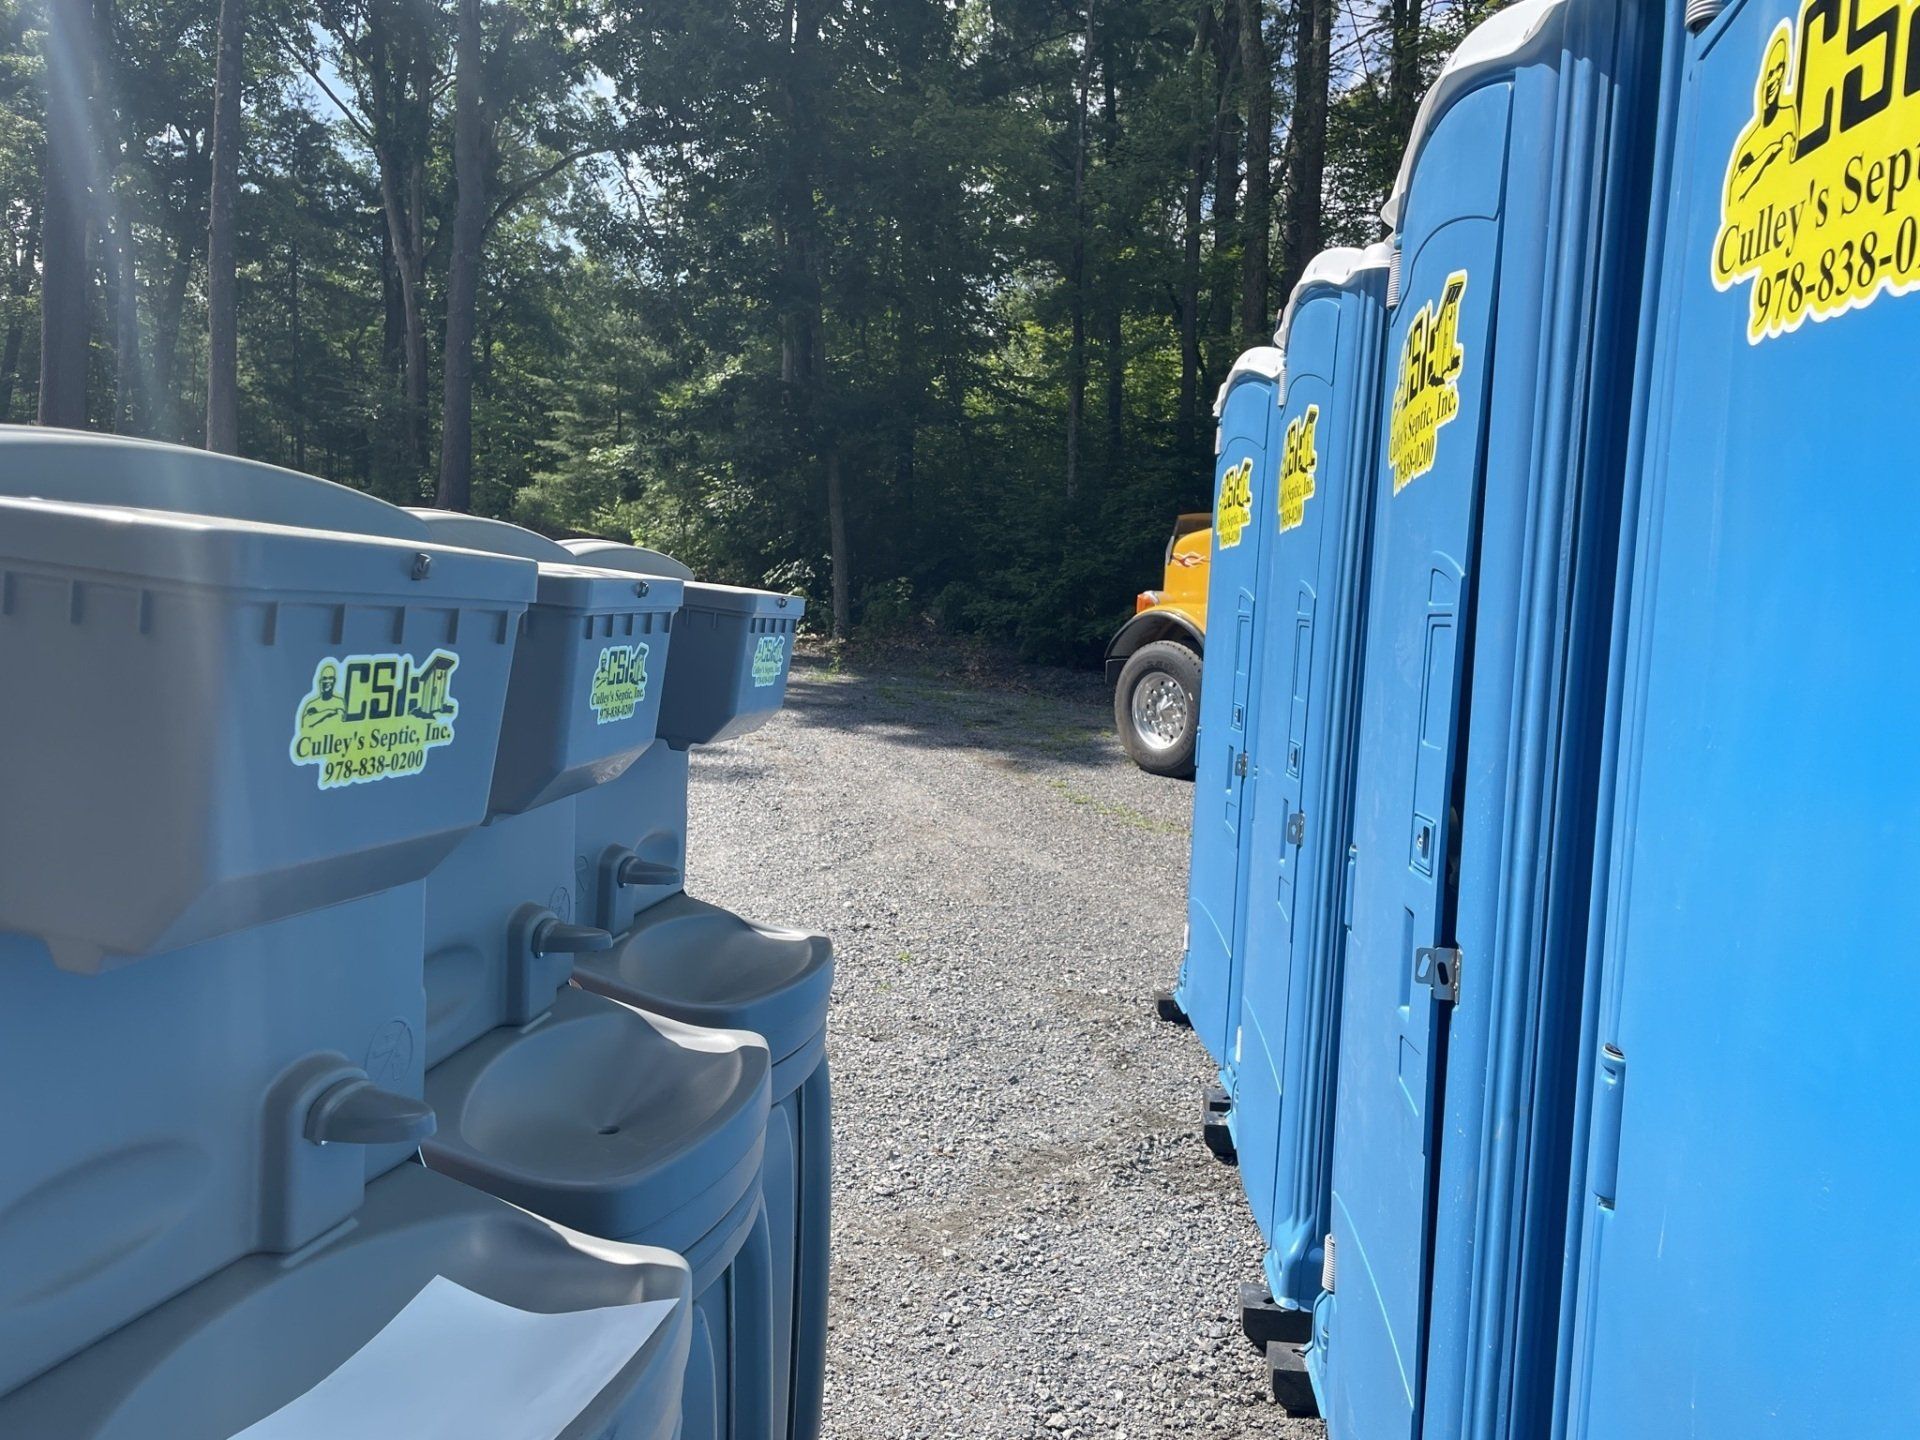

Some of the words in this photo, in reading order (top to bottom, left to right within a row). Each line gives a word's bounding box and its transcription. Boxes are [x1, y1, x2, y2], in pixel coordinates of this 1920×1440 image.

[1718, 178, 1829, 275] Culley's
[1841, 142, 1920, 216] Sep
[1755, 215, 1920, 327] 978-838-0
[1437, 390, 1456, 420] Inc.
[296, 731, 366, 758] Culley's
[369, 725, 421, 752] Septic,
[425, 722, 451, 742] Inc.
[324, 749, 424, 783] 978-838-0200
